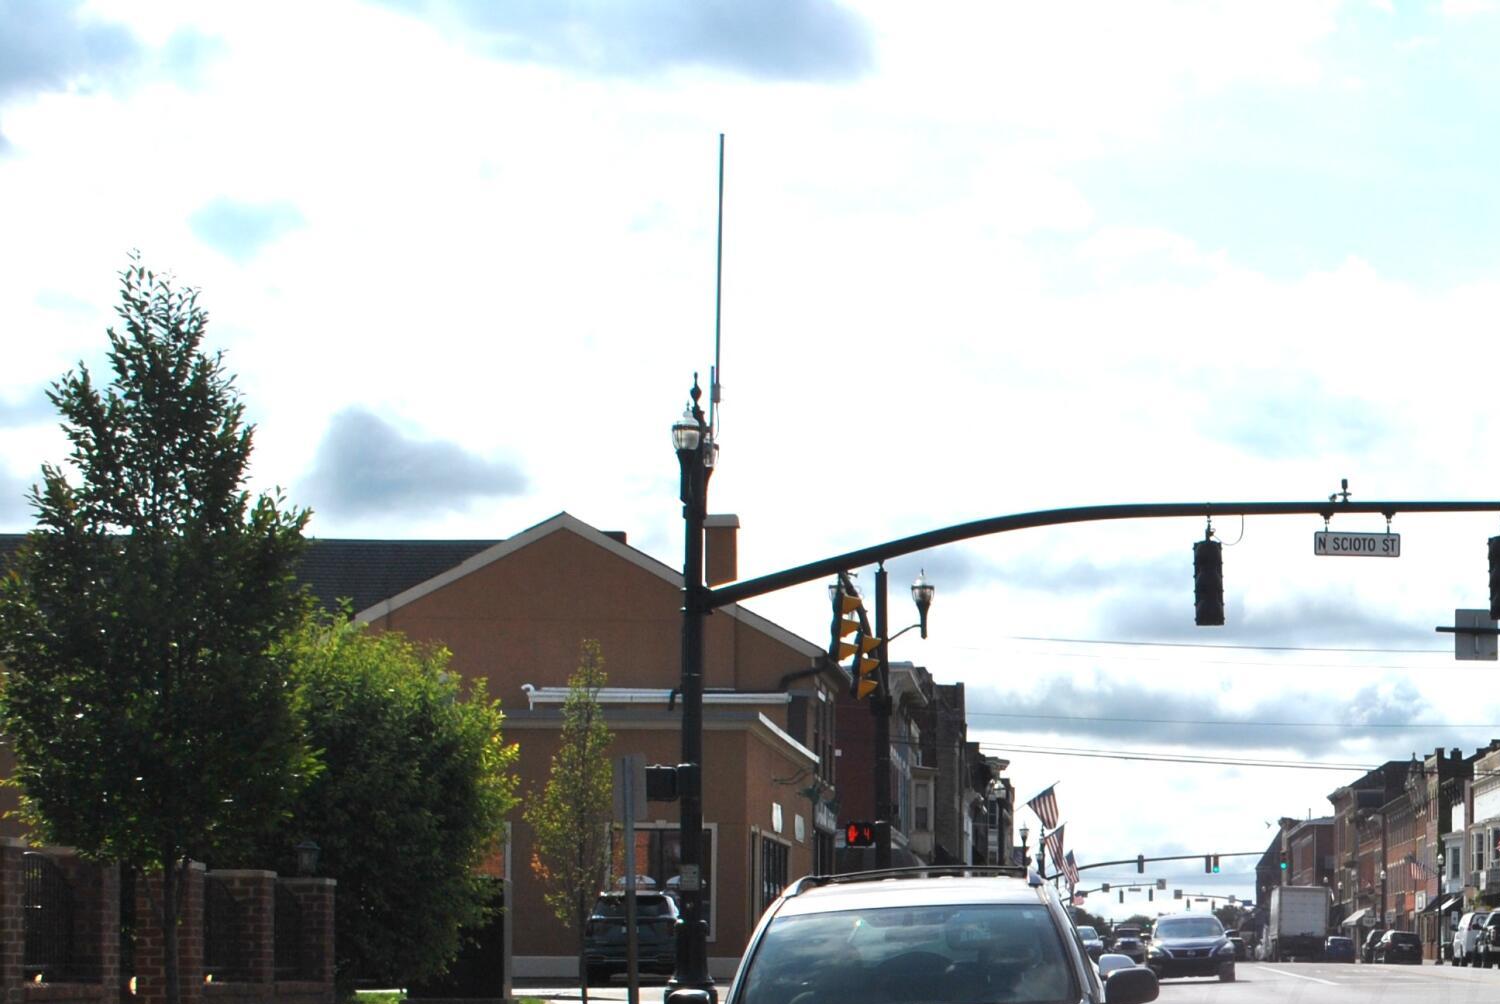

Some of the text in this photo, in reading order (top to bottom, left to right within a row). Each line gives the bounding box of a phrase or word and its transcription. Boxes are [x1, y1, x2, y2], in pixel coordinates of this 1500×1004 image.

[1318, 537, 1397, 553] N SCIOTO ST
